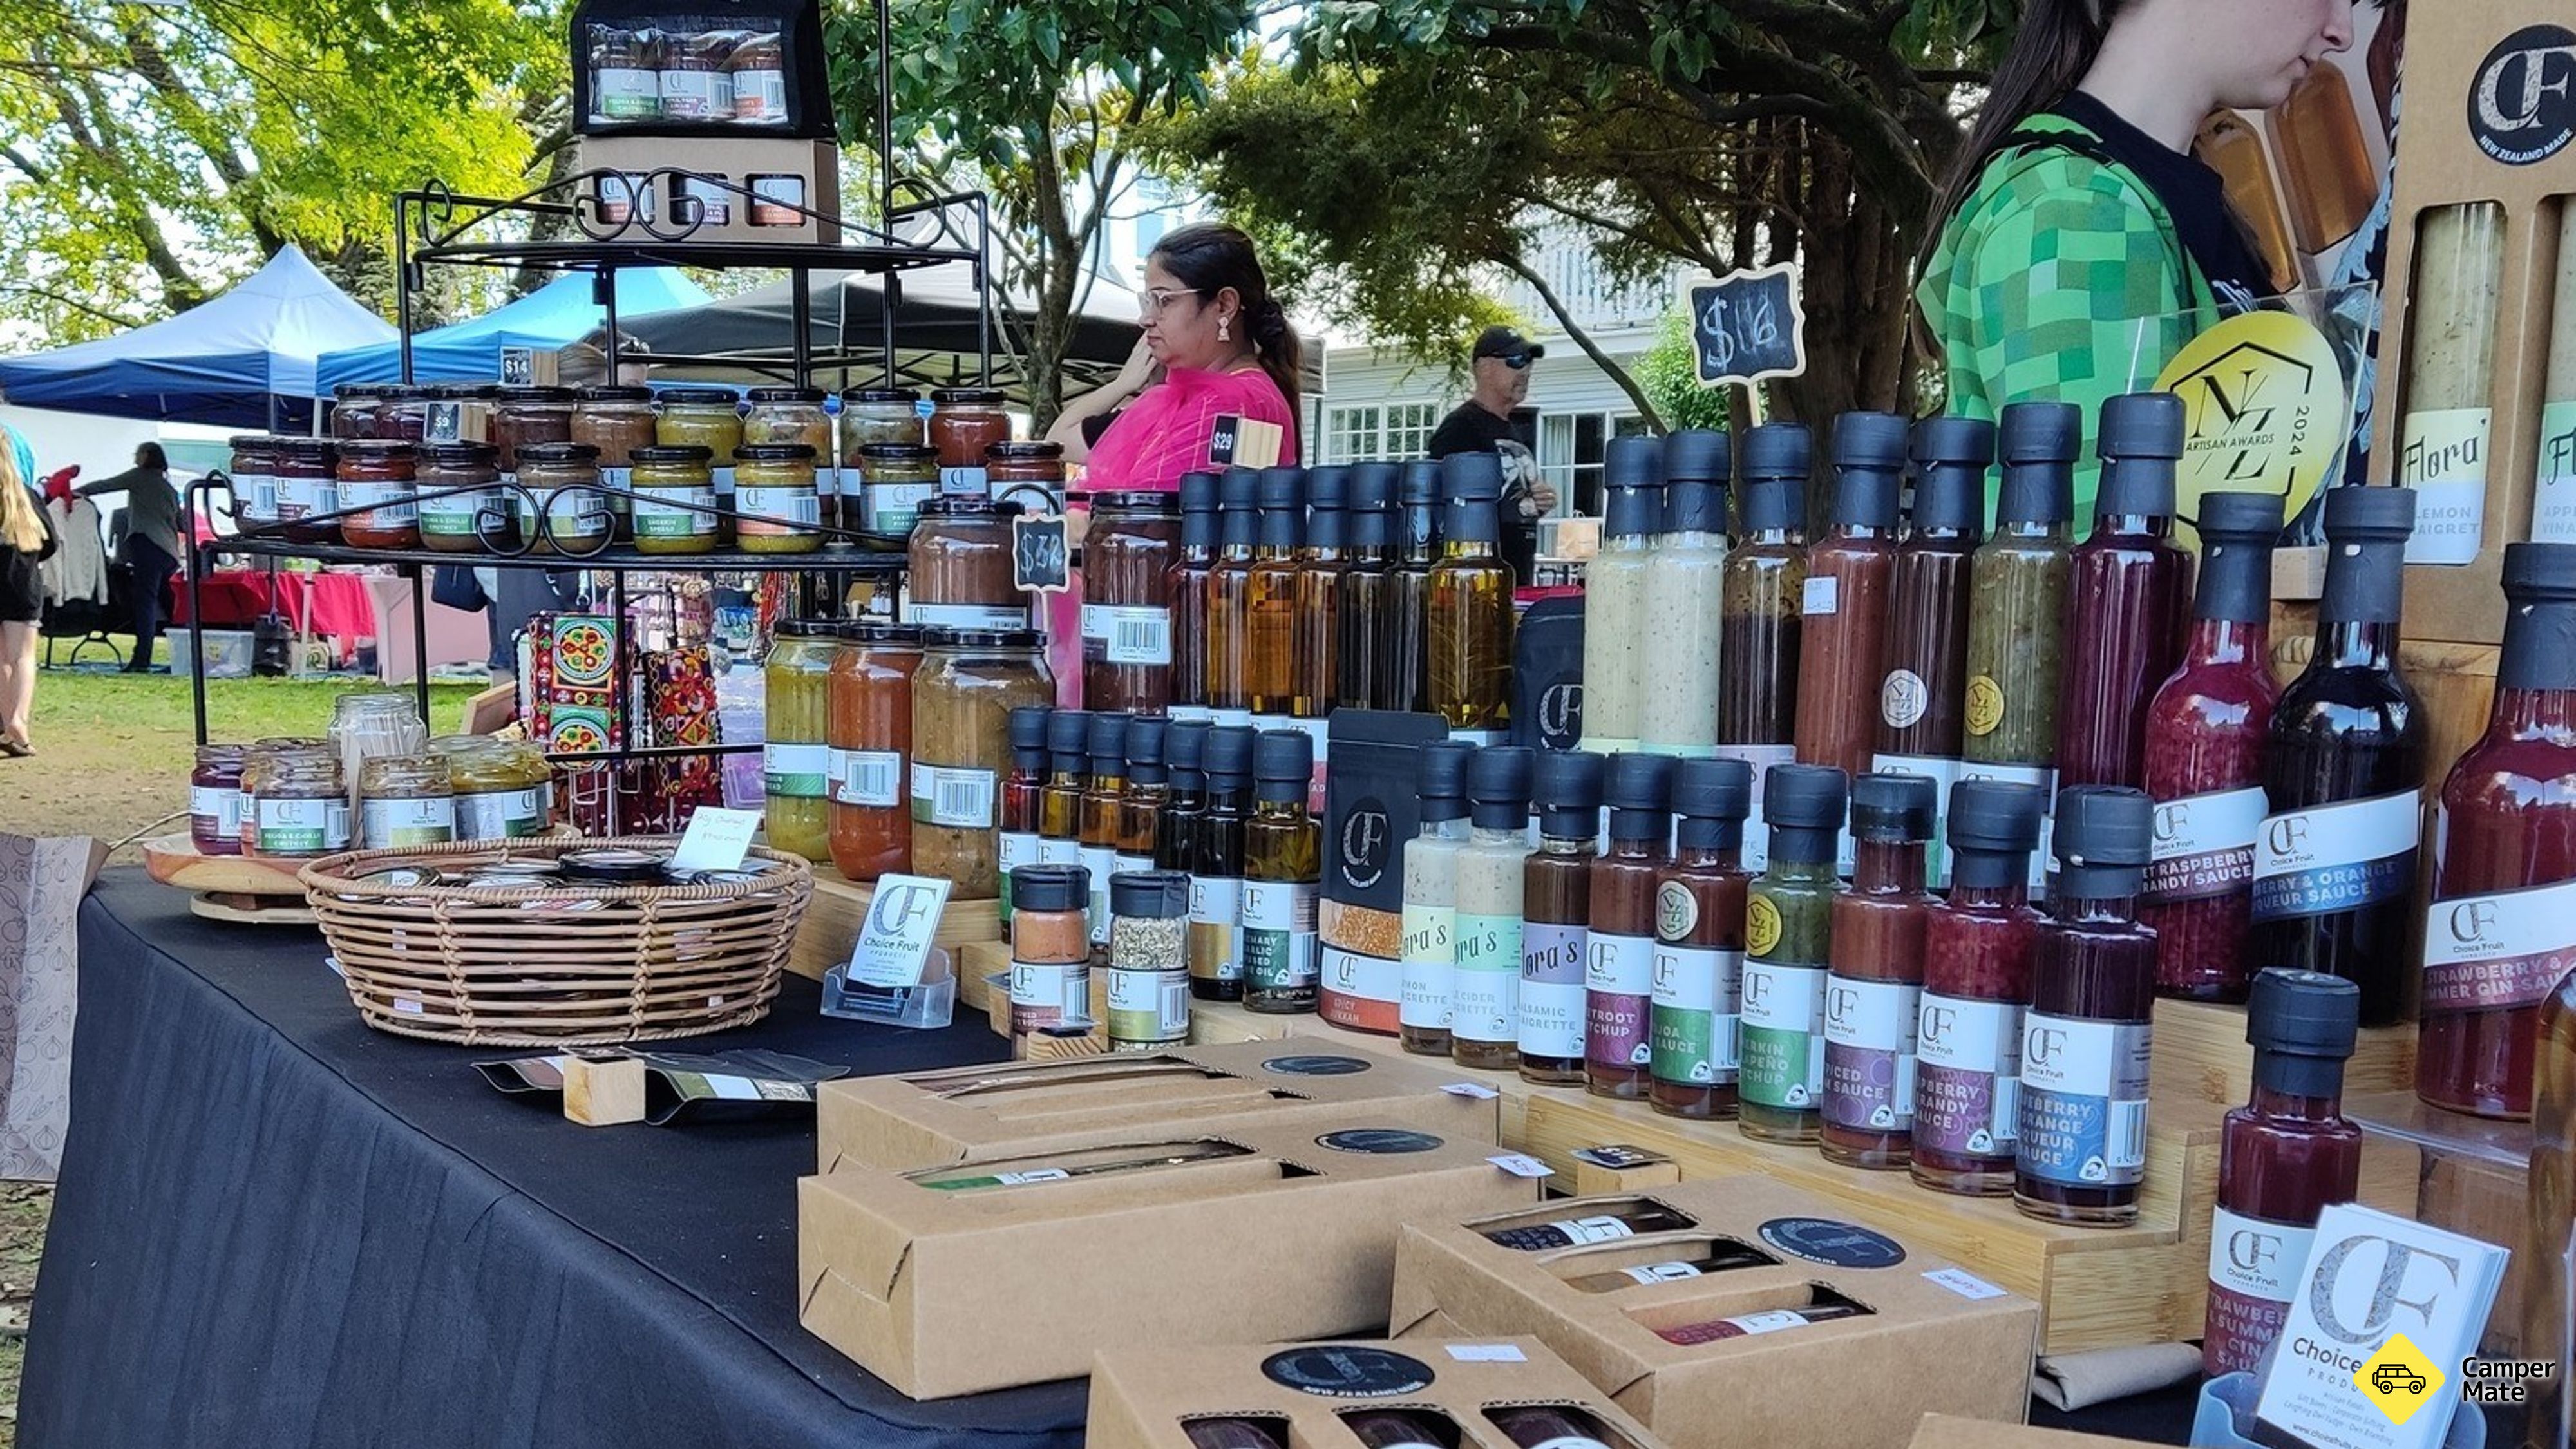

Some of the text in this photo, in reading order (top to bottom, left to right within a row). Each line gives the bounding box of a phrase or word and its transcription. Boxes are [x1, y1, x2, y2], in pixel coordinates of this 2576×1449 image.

[2479, 127, 2573, 161] NEW ZEALAND MADE
[505, 360, 528, 374] $14
[435, 415, 450, 428] $9
[2289, 405, 2310, 456] 2024
[2186, 433, 2275, 451] ARTISAN AWARDS
[2417, 507, 2472, 519] EMON
[2142, 864, 2252, 893] RANDY SAUCE
[2254, 862, 2395, 896] BERRY & ORANGE
[2255, 881, 2371, 911] QUEUR SAUCE
[864, 937, 920, 952] Choice Fruit
[2453, 942, 2505, 953] Choice Fruit
[2427, 956, 2562, 984] STRAWBERRY &
[2477, 980, 2515, 998] GIN
[1833, 1081, 1884, 1099] SAUCE
[1918, 1094, 1970, 1115] RANDY
[2226, 1267, 2279, 1288] Choice Fruit
[2293, 1337, 2363, 1374] Choice
